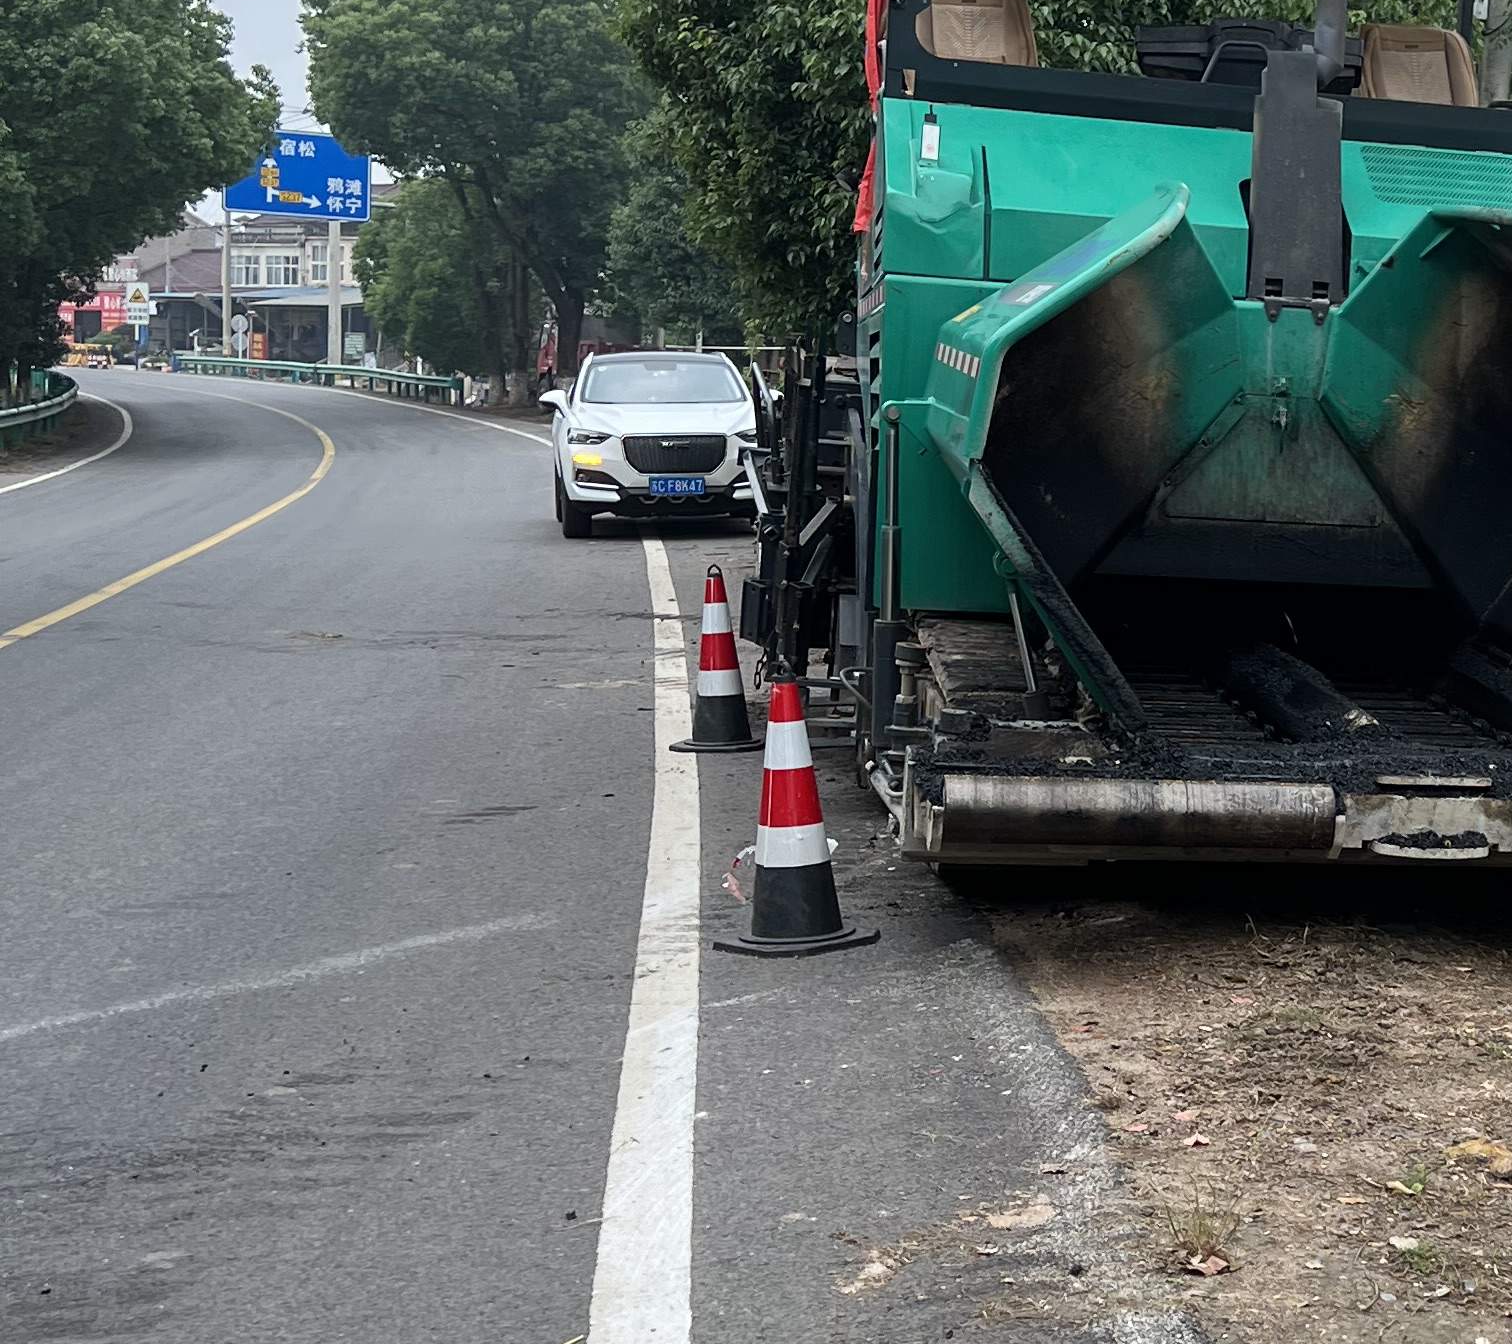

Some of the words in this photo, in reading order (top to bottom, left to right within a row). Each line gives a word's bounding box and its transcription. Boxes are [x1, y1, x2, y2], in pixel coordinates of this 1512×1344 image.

[280, 139, 316, 158] 宿松
[327, 177, 362, 196] 鸦滩
[327, 196, 362, 214] 怀宁
